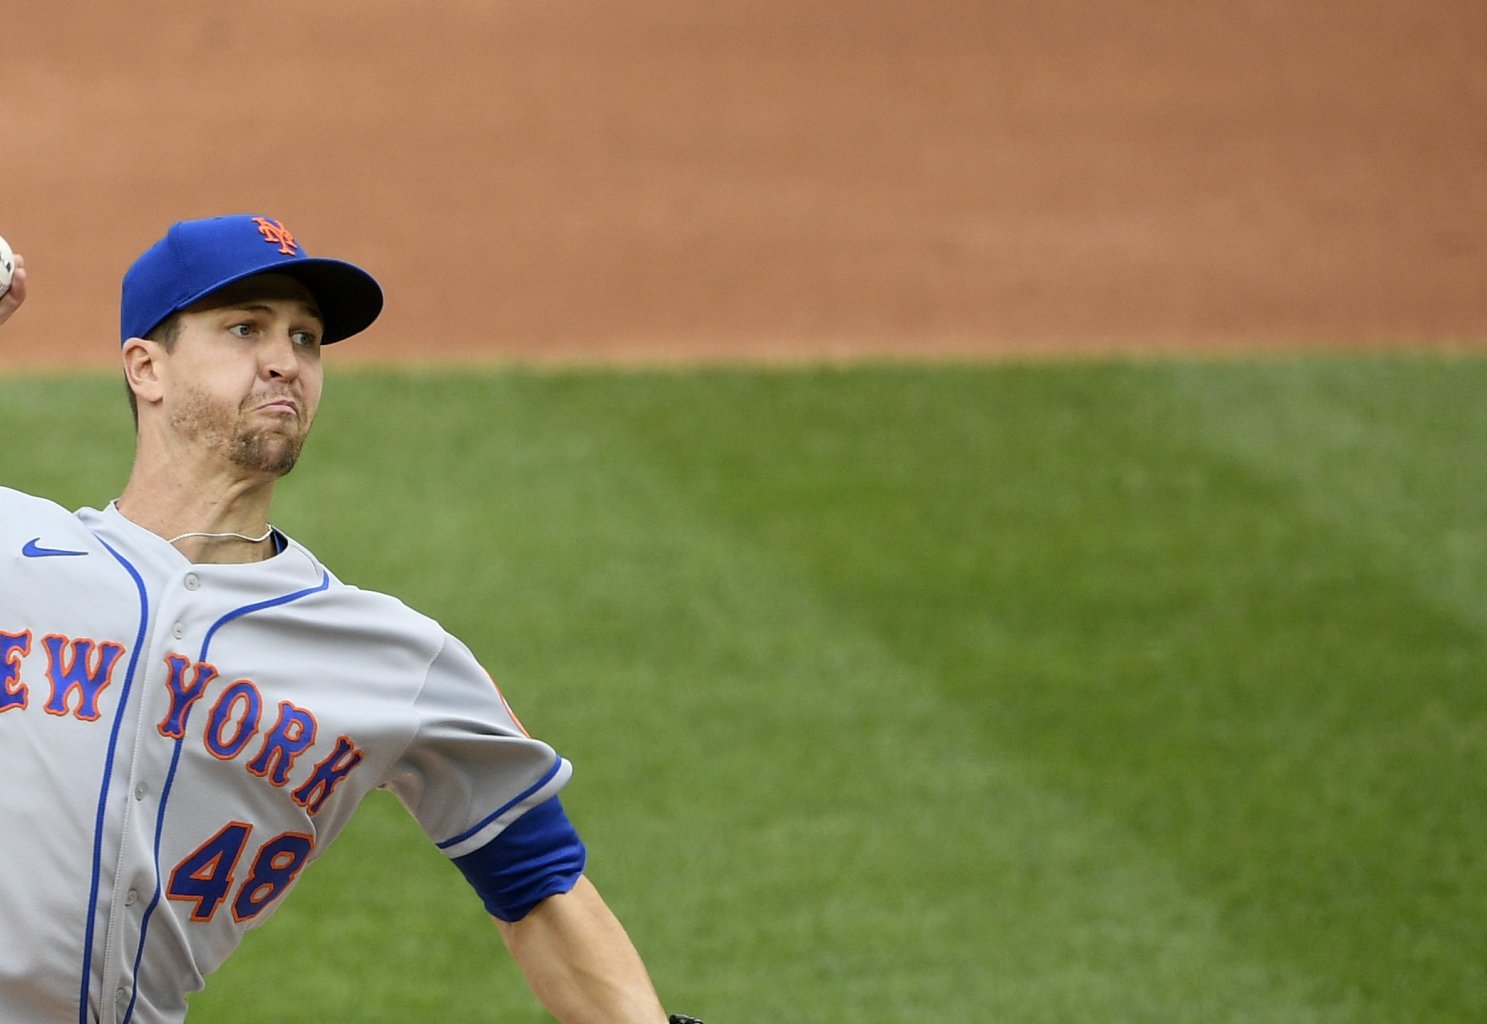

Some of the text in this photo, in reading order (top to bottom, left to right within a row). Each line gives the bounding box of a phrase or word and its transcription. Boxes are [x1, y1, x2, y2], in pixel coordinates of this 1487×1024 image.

[252, 217, 298, 256] NY
[157, 652, 364, 814] YORK
[166, 821, 313, 923] 48
